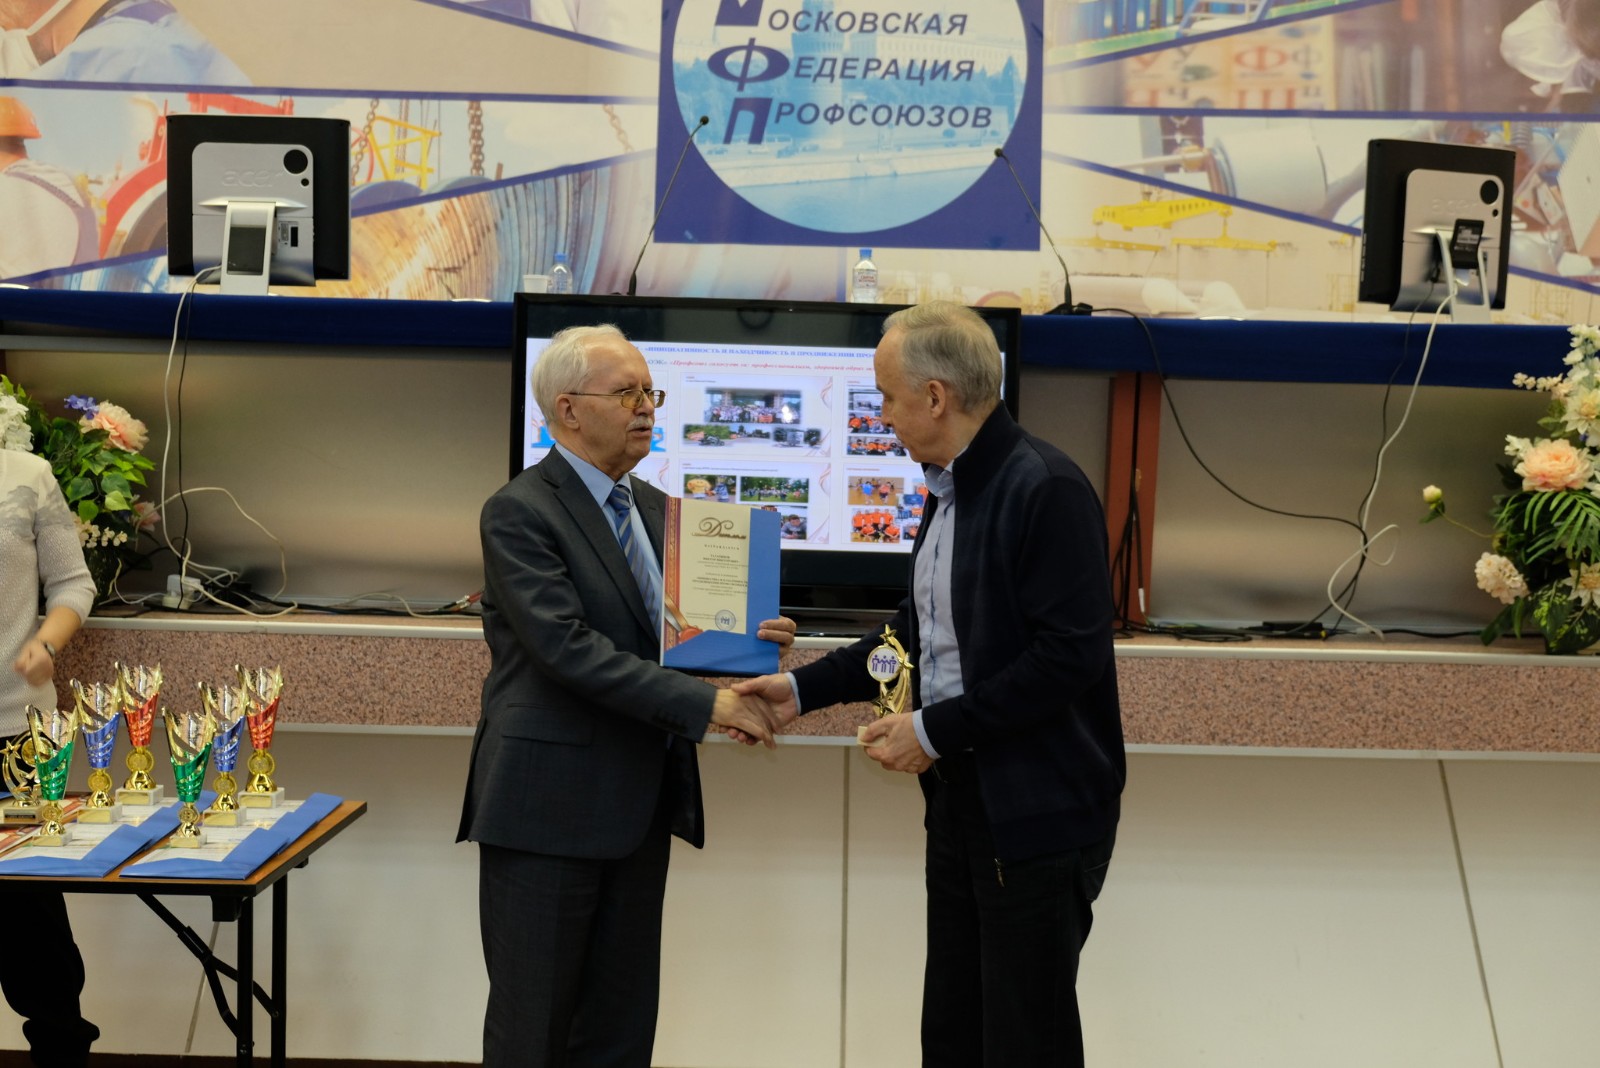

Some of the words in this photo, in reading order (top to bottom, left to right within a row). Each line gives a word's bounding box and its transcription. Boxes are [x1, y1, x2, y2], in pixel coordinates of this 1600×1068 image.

[707, 37, 975, 92] ФЕДЕРАЦИЯ
[722, 97, 992, 145] ПРОФСОЮЗОВ
[222, 169, 284, 188] acer
